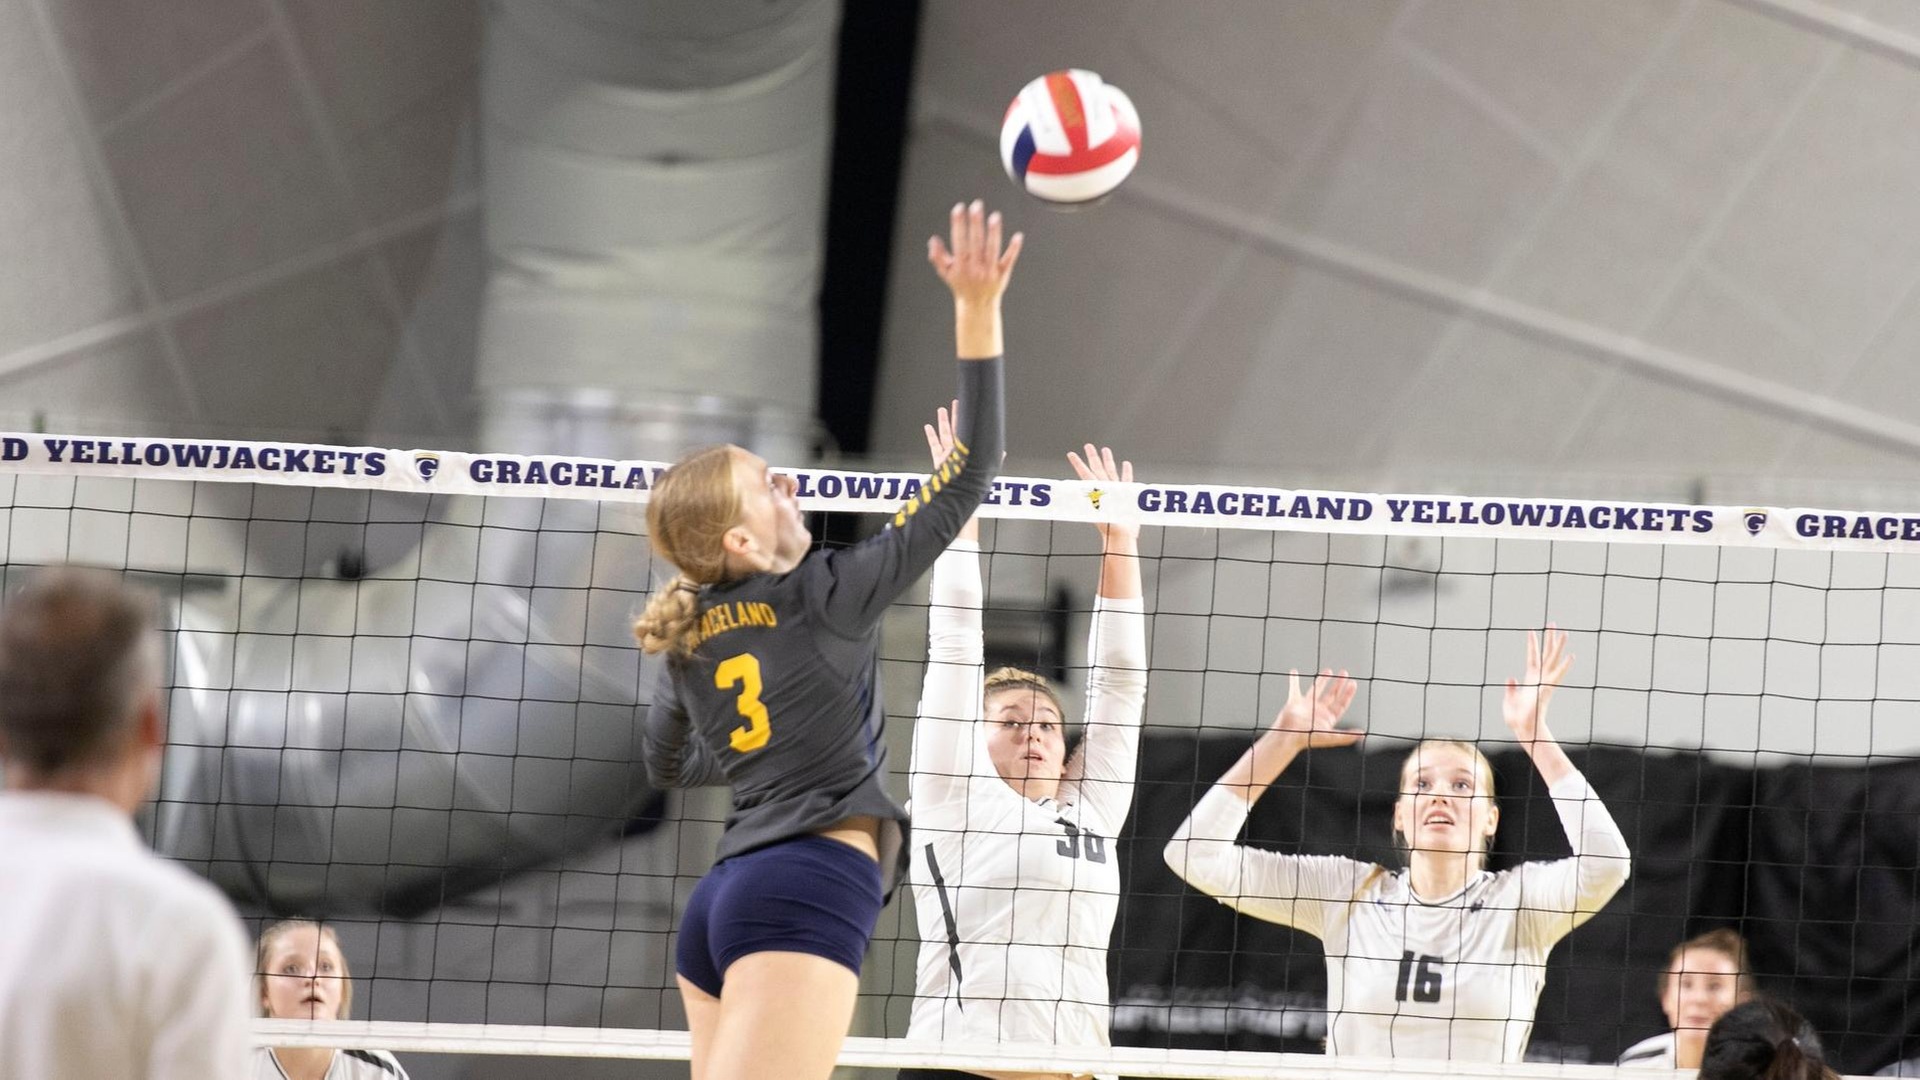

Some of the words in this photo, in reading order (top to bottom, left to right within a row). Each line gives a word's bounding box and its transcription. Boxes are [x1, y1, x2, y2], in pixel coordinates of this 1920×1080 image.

[43, 439, 386, 477] YELLOWJACKETS
[469, 459, 668, 490] GRACELA
[1137, 488, 1373, 522] GRACELAND
[1386, 499, 1714, 533] YELLOWJACKETS
[1796, 514, 1920, 541] GRACE
[688, 601, 777, 653] ACELAND
[715, 653, 771, 752] 3
[1395, 950, 1444, 1003] 16
